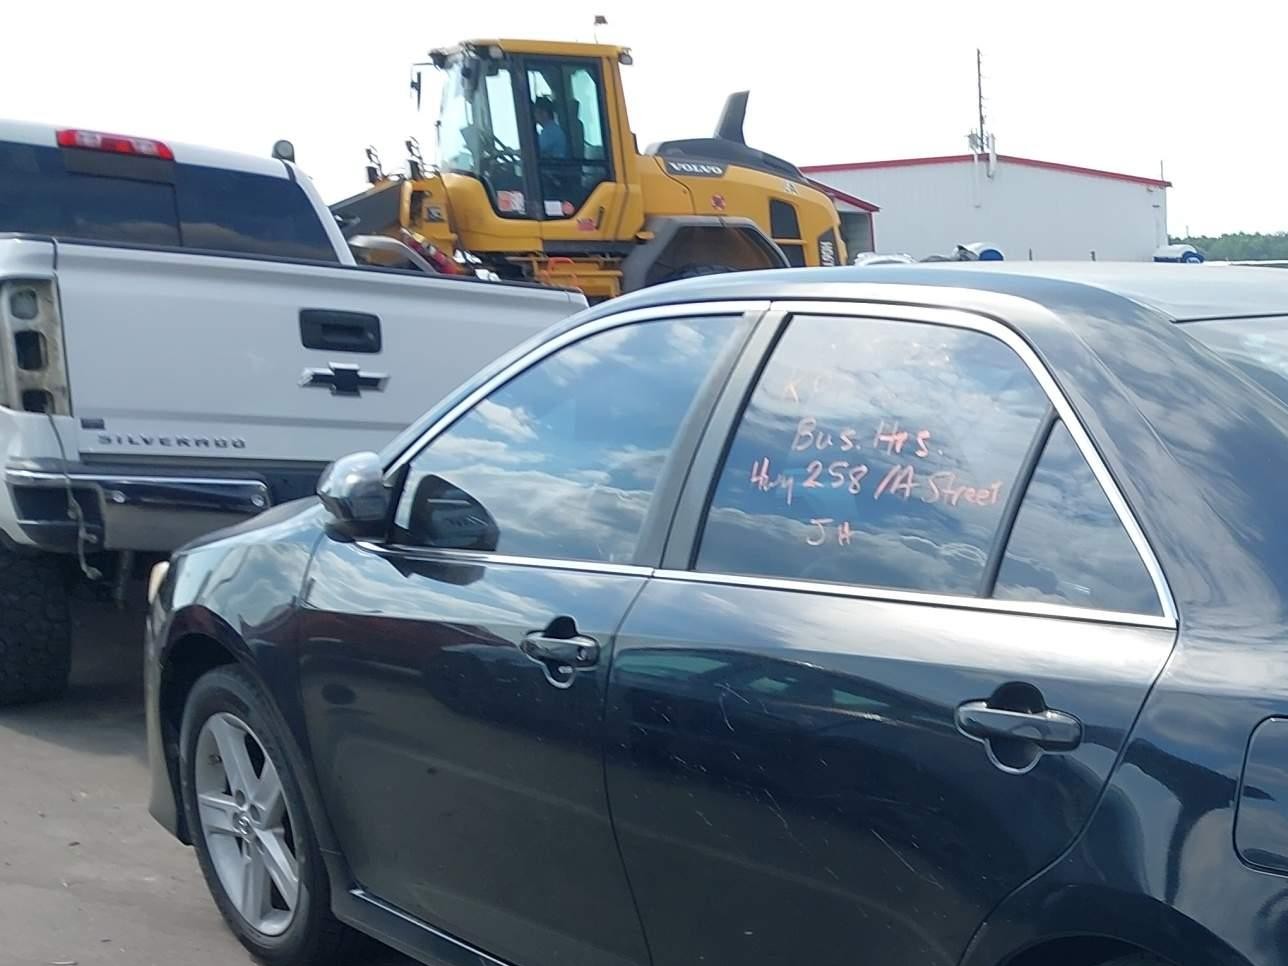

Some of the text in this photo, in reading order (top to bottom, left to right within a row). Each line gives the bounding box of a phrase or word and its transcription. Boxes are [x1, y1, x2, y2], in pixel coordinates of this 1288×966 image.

[669, 161, 723, 175] VOLVO
[98, 433, 246, 449] SILVERADO
[792, 416, 861, 452] Bus.
[751, 457, 792, 505] Hwy
[803, 460, 868, 495] 258
[921, 471, 1003, 506] Street
